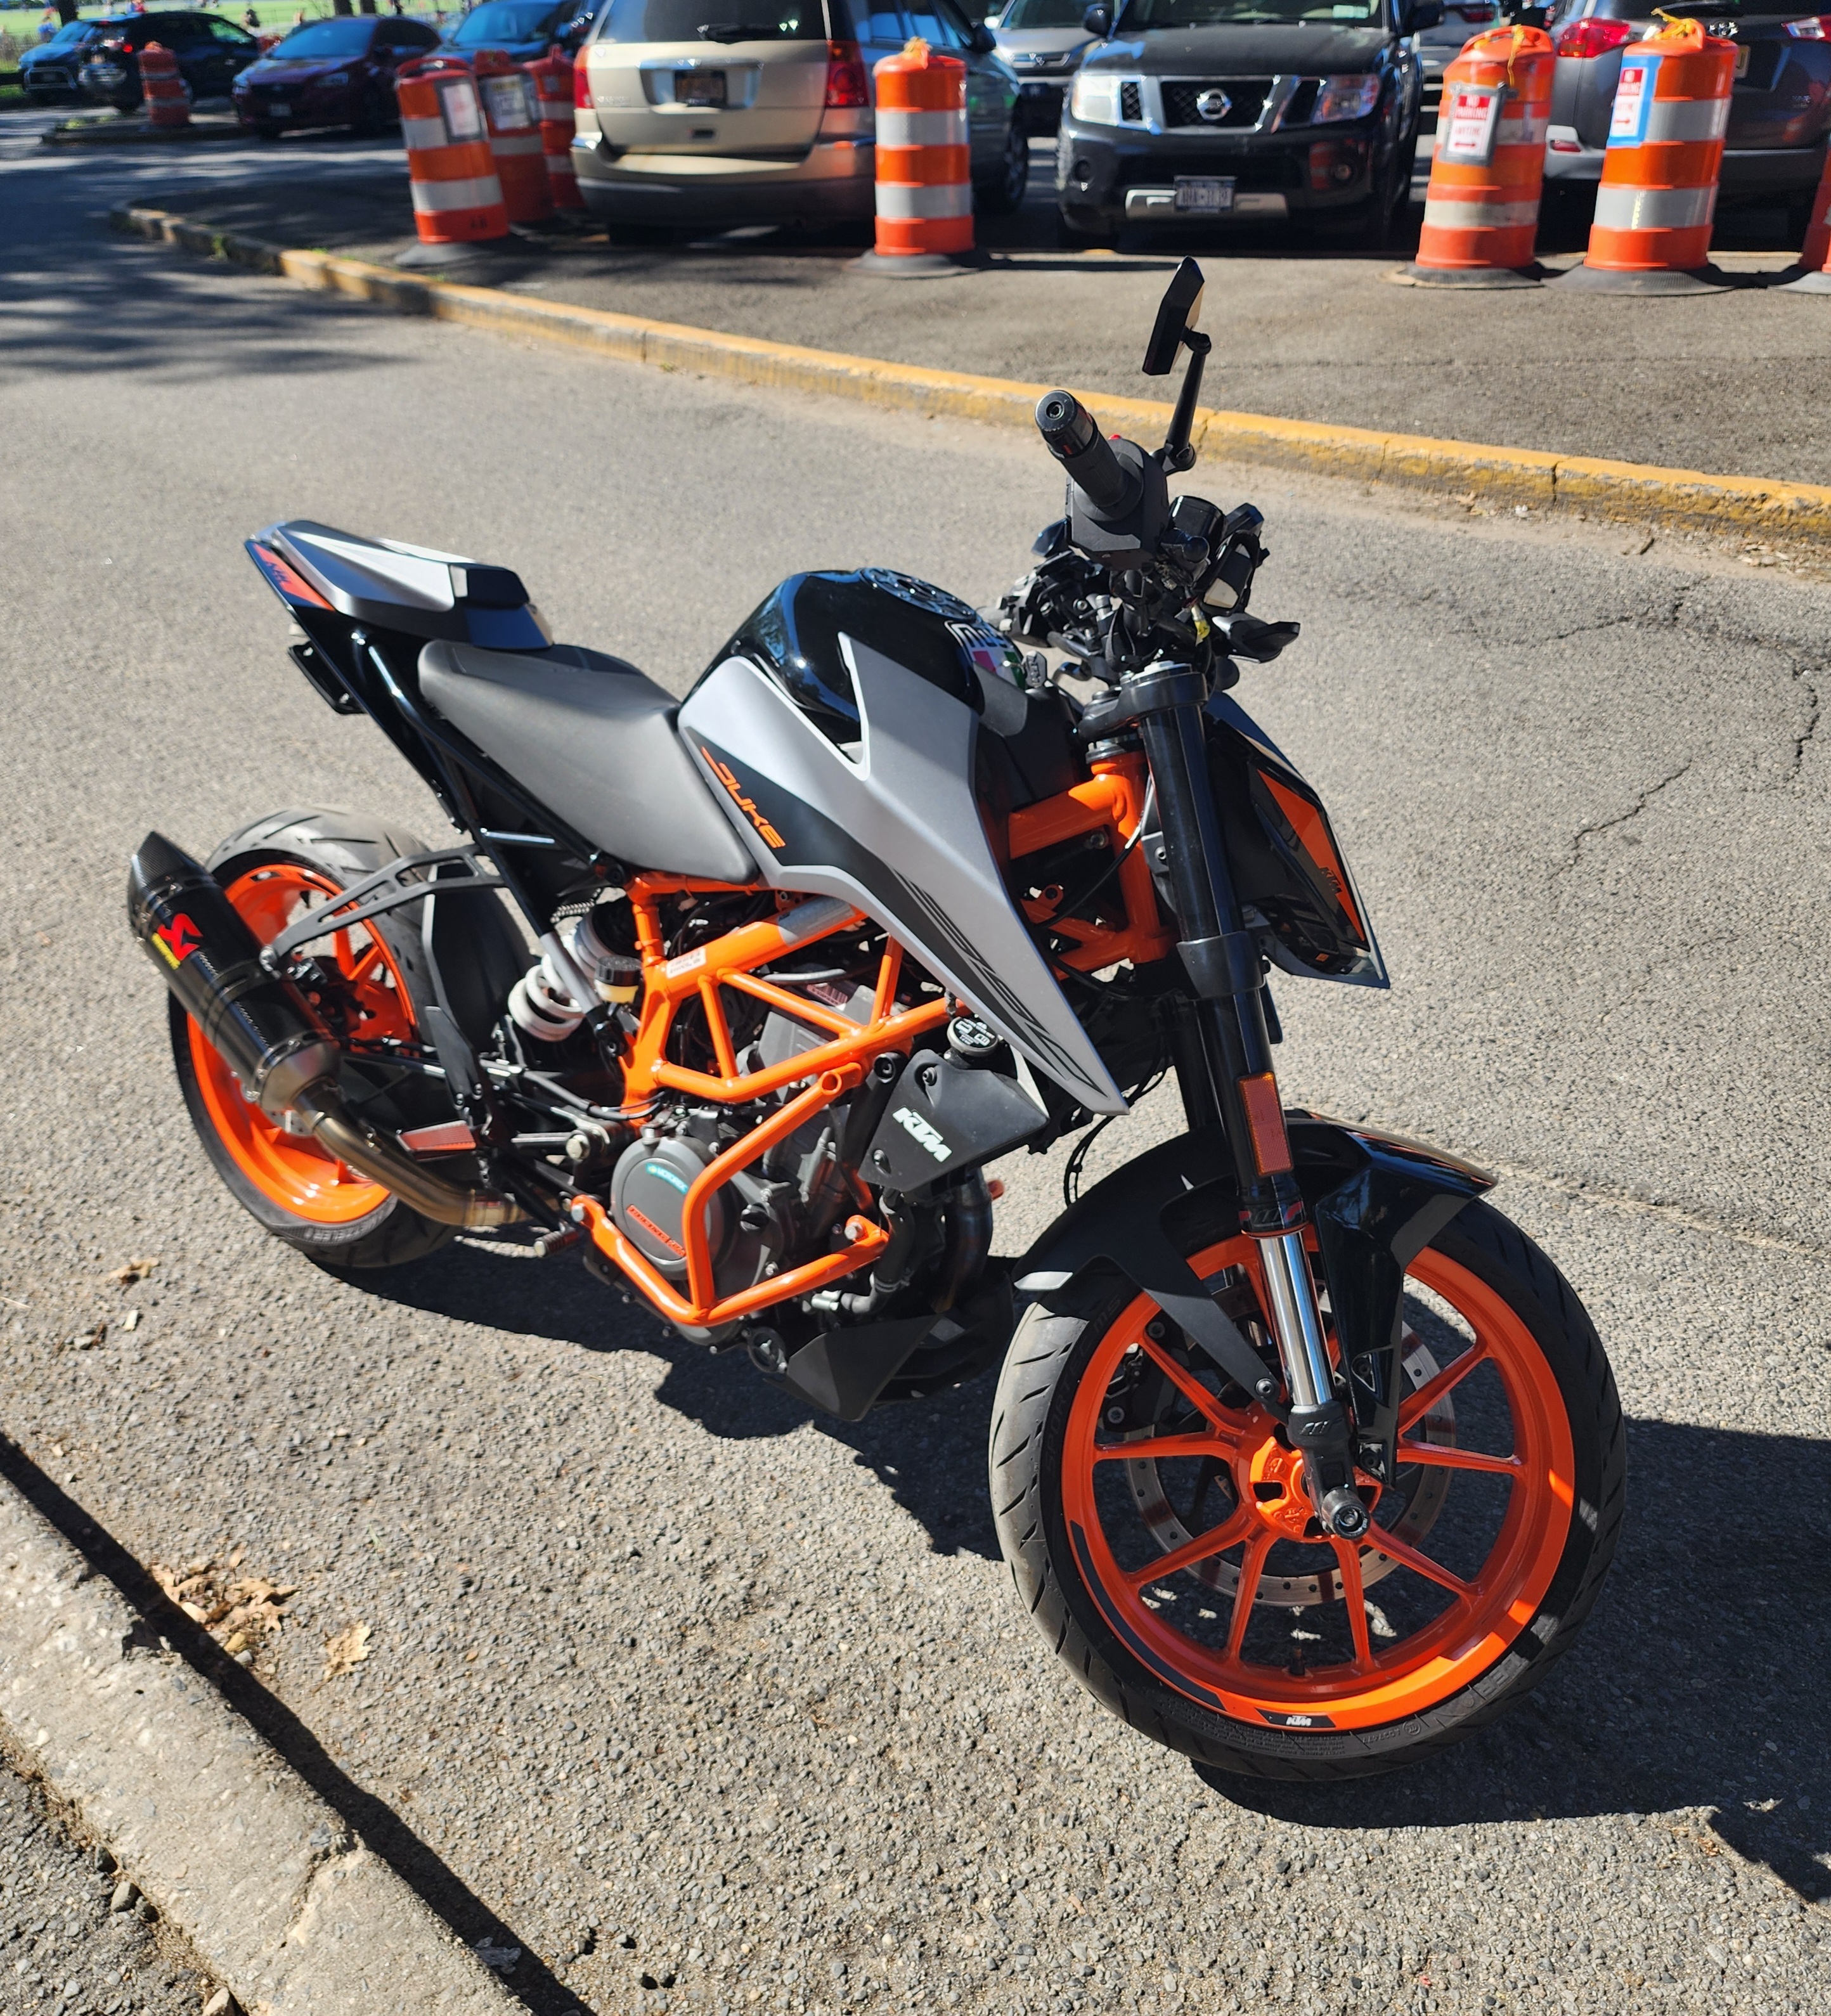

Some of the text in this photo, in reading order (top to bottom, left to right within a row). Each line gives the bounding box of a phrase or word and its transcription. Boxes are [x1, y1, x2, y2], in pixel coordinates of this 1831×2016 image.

[1466, 94, 1480, 107] NO
[1455, 107, 1487, 119] PARKING
[701, 746, 786, 848] DUKE
[893, 1107, 952, 1163] KTM
[1286, 1716, 1312, 1727] KTM
